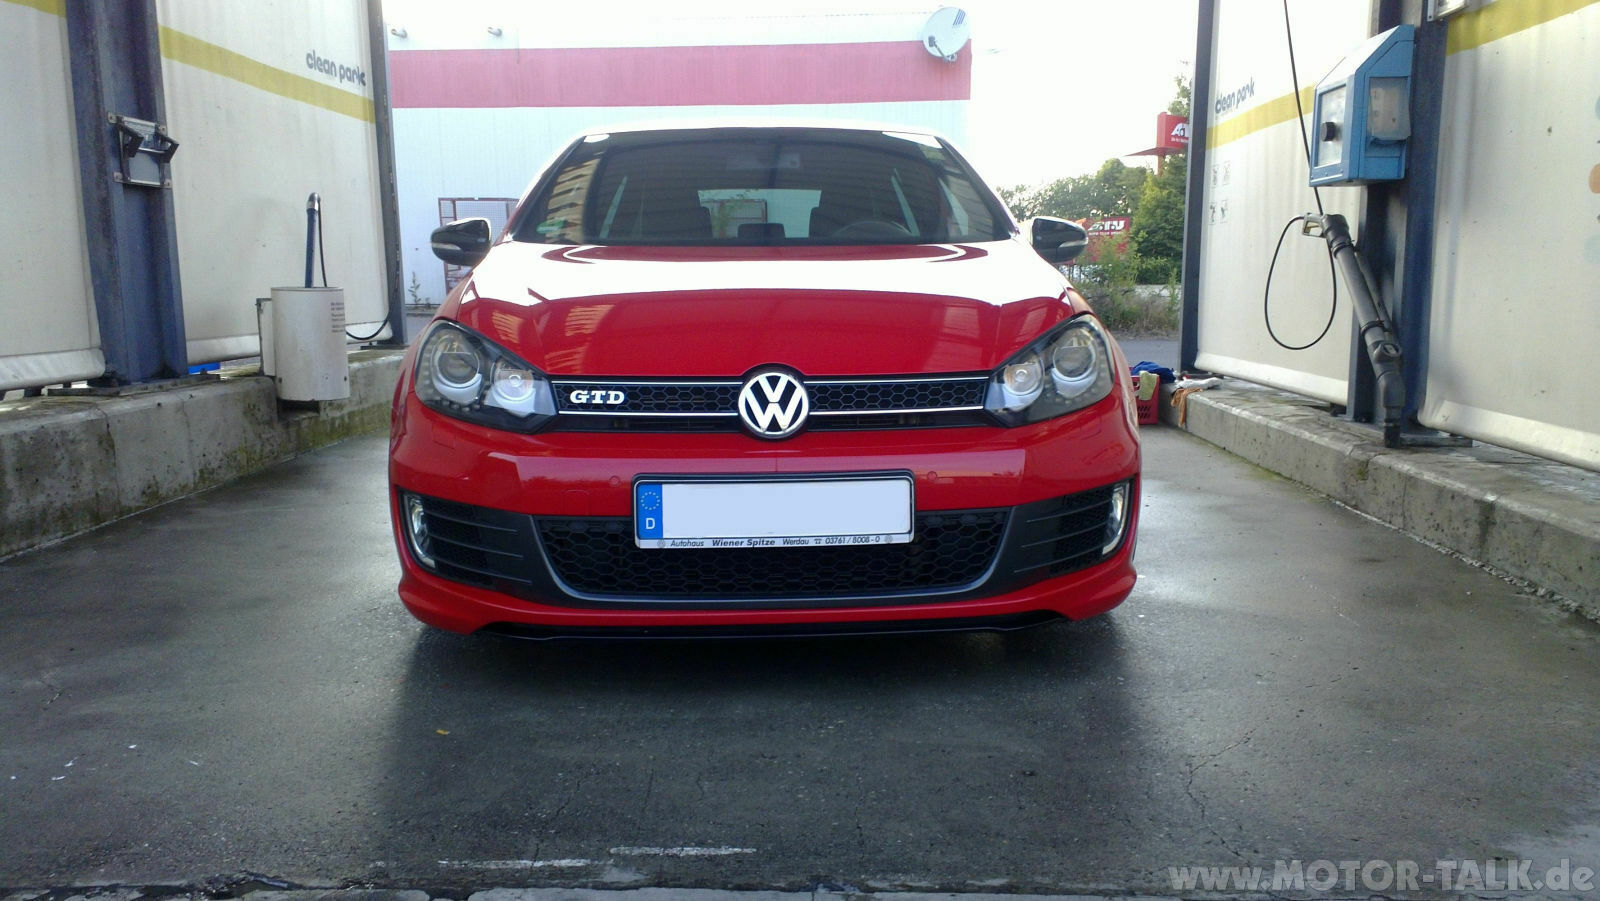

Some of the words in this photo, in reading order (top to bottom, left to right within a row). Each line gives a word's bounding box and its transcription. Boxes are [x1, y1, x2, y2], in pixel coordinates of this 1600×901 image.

[306, 50, 337, 78] clean
[339, 64, 366, 87] park
[1215, 92, 1236, 114] clean
[1236, 77, 1255, 109] park
[569, 389, 626, 405] GTD
[741, 373, 807, 434] VW
[645, 517, 656, 530] D
[746, 538, 776, 547] Spitze
